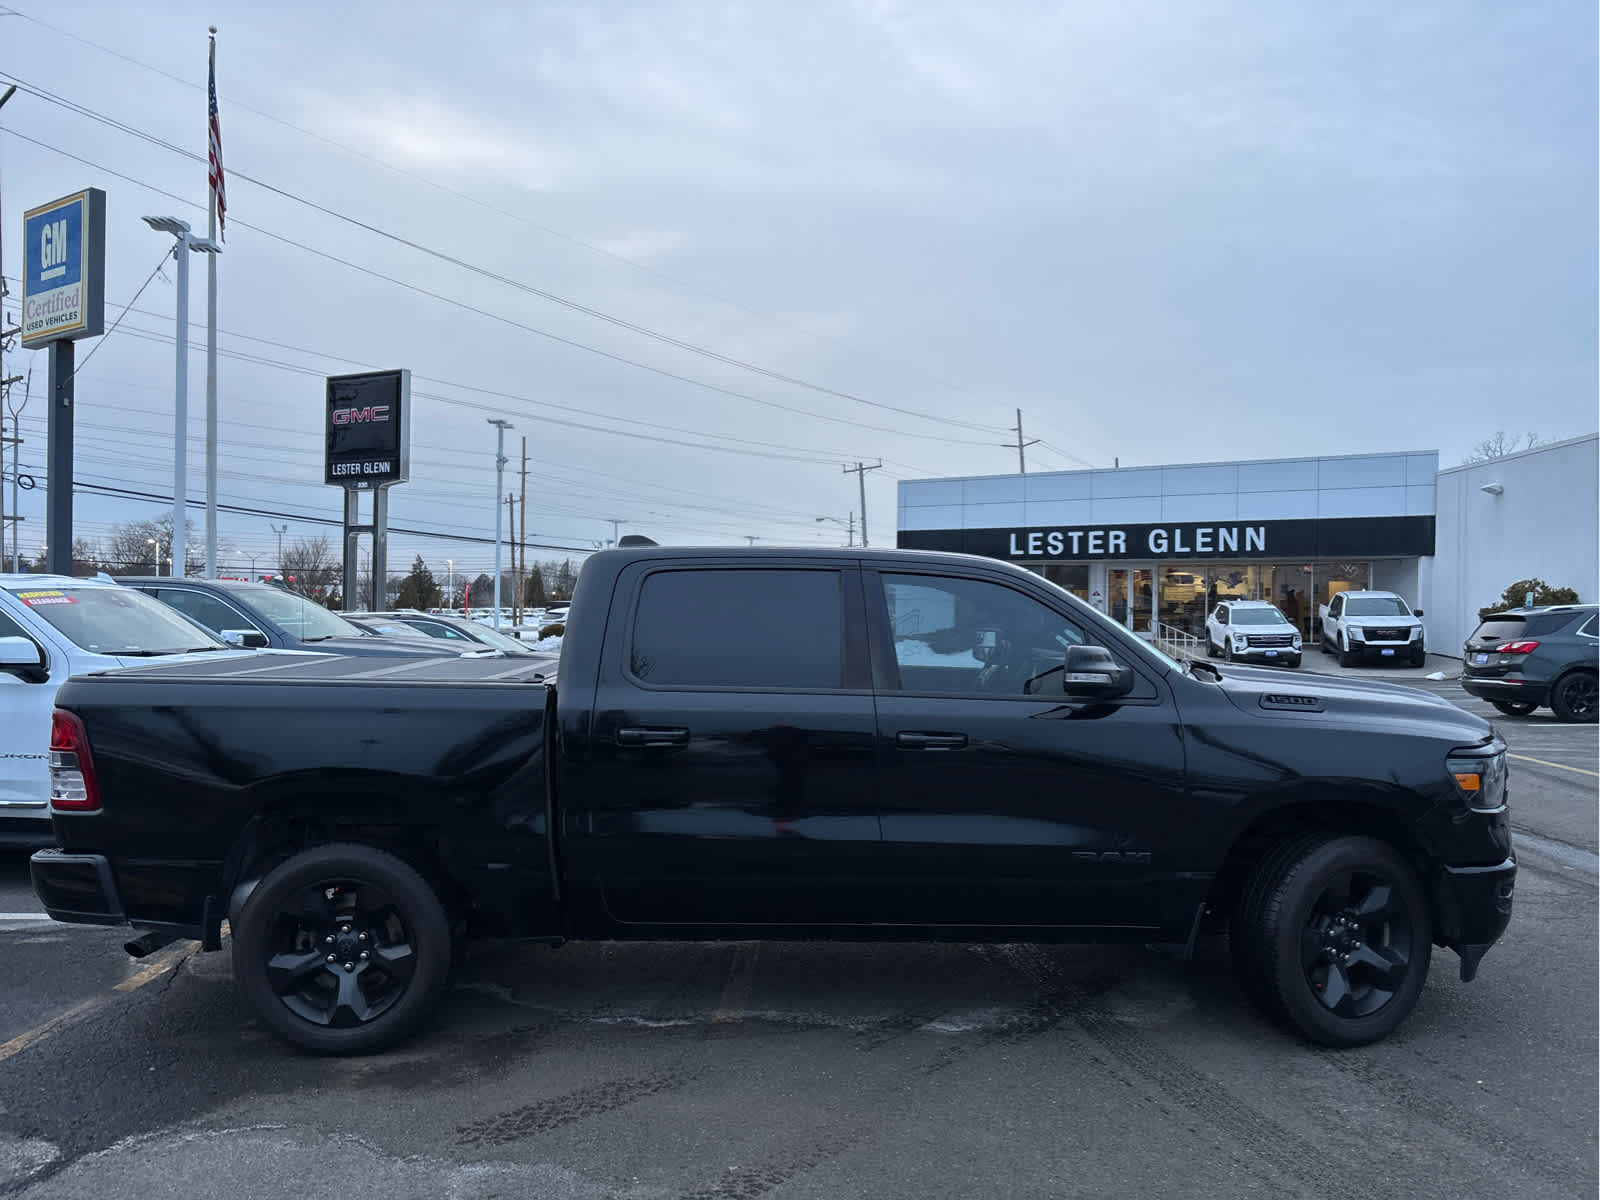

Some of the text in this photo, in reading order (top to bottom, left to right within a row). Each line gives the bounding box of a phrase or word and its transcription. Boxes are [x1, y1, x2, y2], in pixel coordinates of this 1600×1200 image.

[41, 219, 67, 270] GM
[26, 287, 80, 320] Certified
[26, 311, 78, 331] USED VEHICLES
[332, 405, 389, 425] GMC
[332, 461, 390, 475] LESTER GLENN
[1009, 527, 1265, 555] LESTER GLENN
